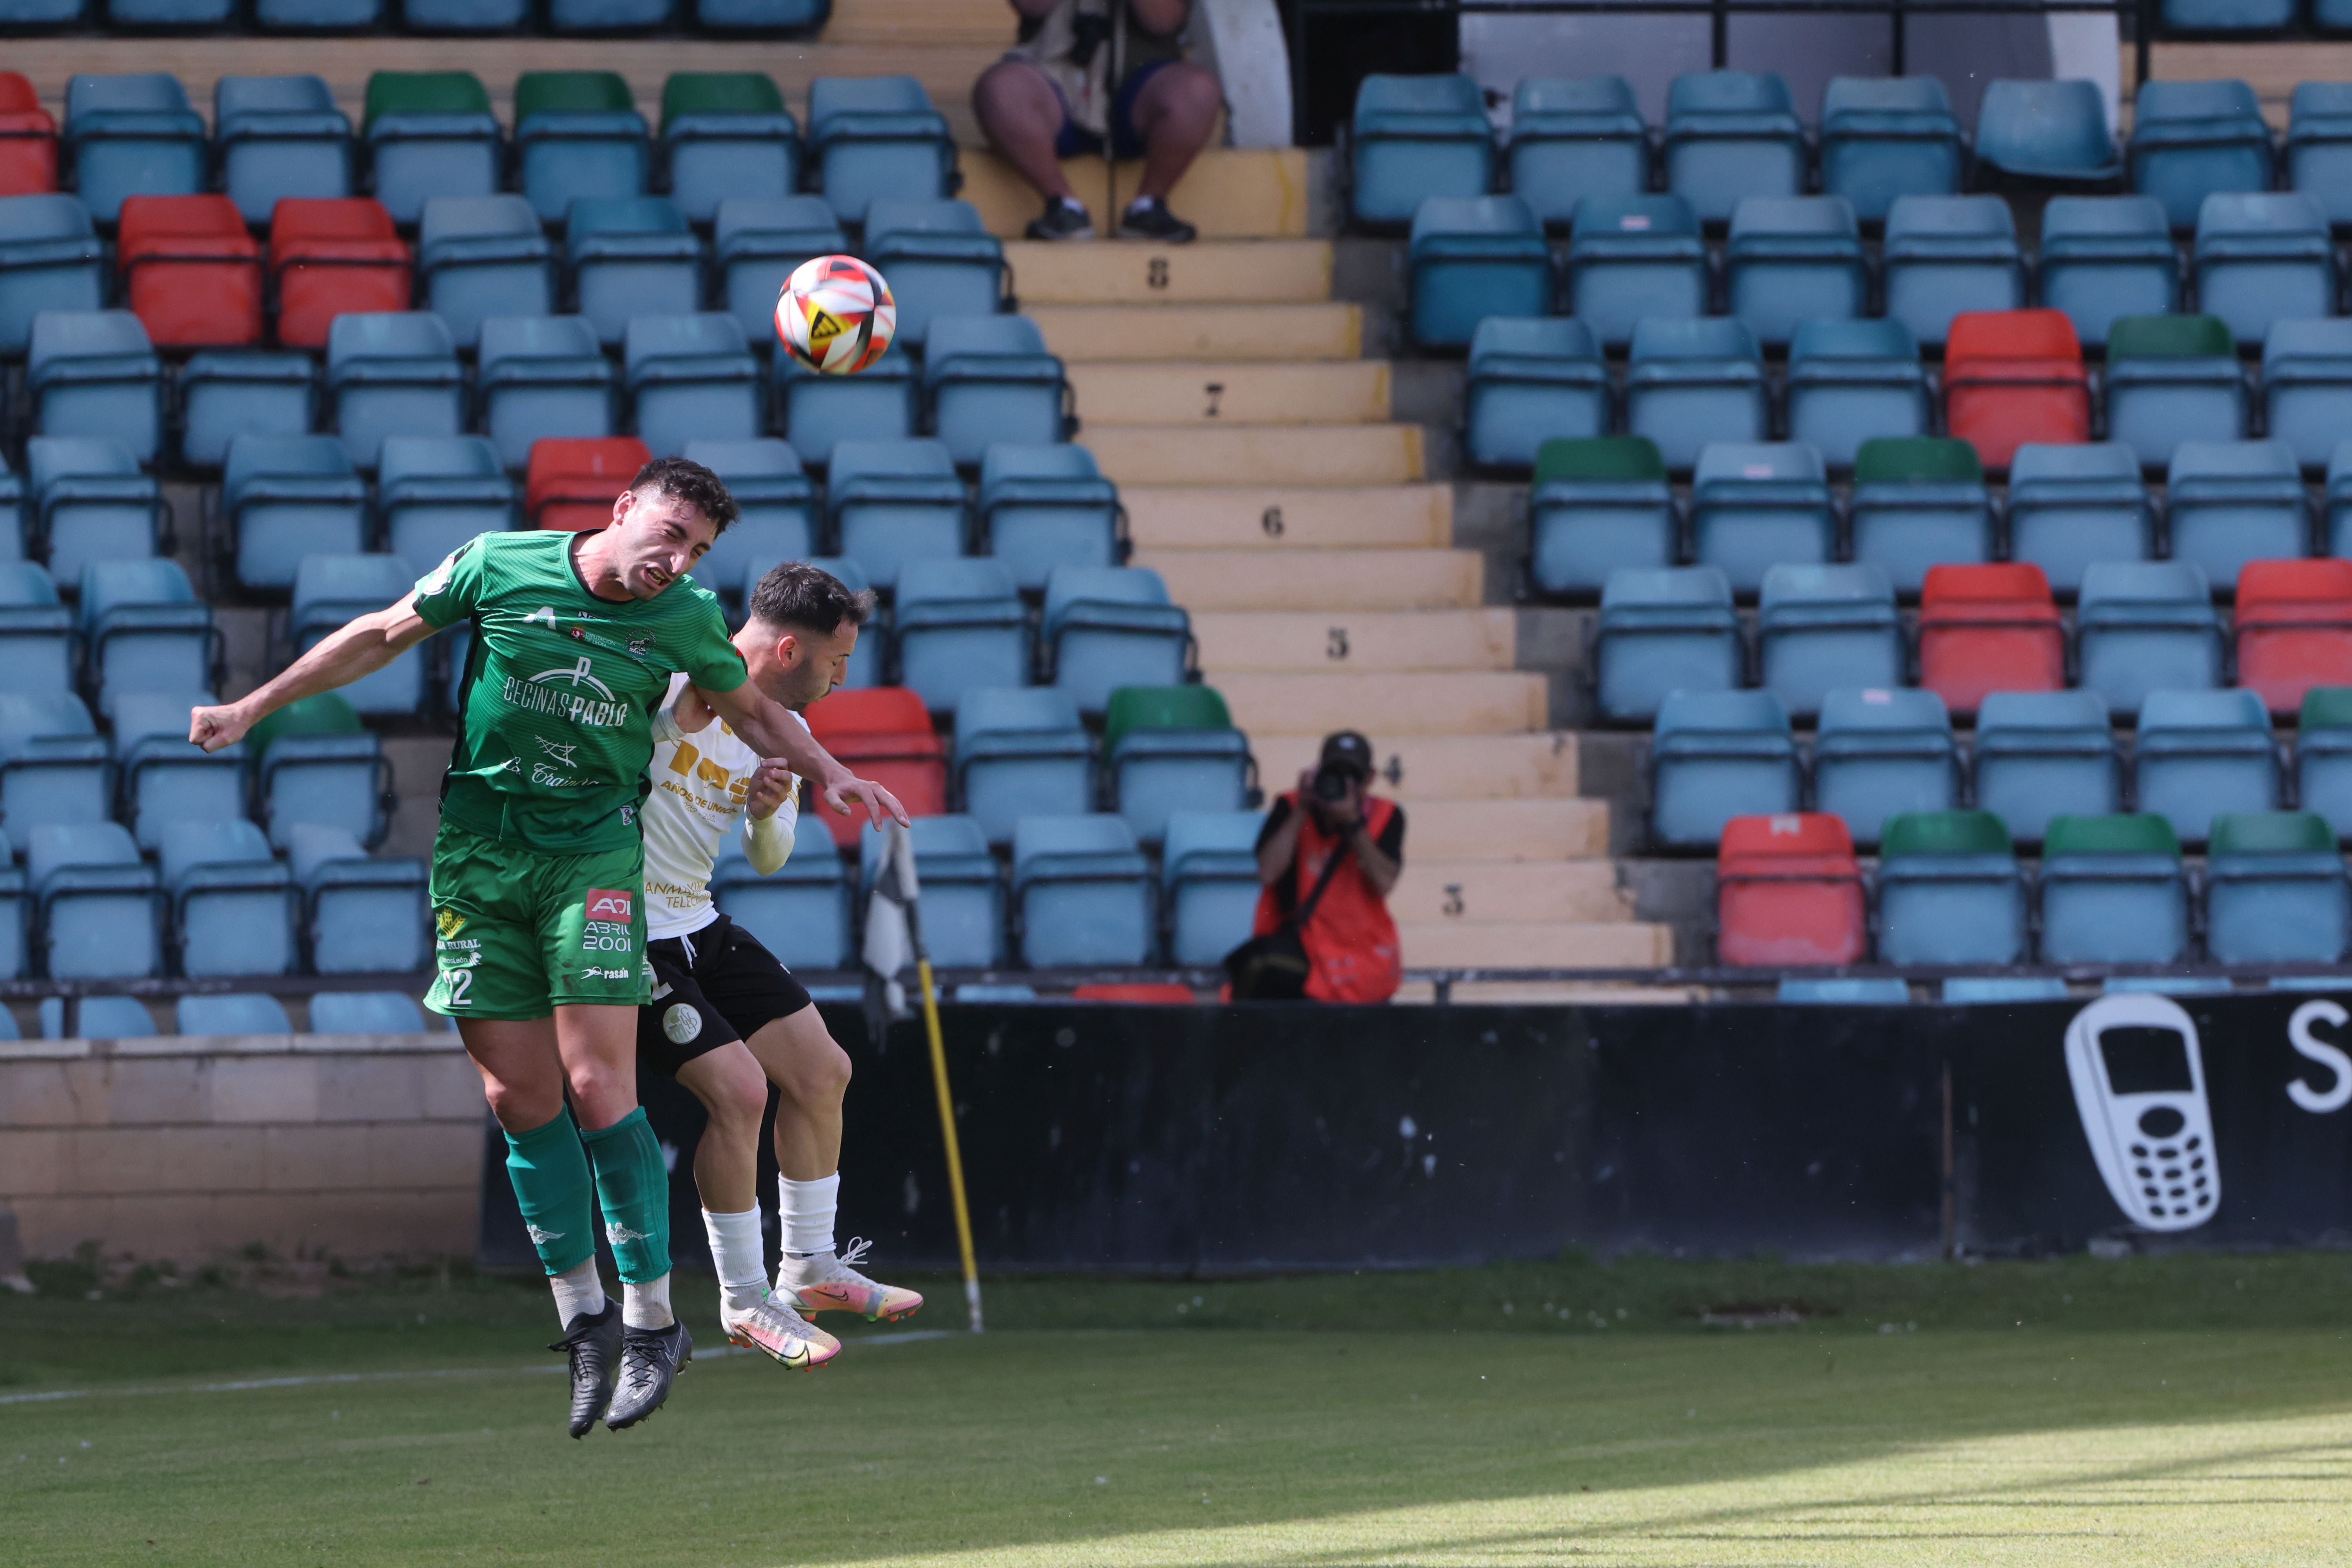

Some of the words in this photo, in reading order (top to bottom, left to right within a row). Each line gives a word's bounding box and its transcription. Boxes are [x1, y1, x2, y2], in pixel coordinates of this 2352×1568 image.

[1147, 258, 1170, 289] 8
[1204, 383, 1224, 417] 7
[1261, 506, 1285, 538] 6
[1326, 627, 1350, 661] 5
[503, 677, 569, 717] CECINAS
[569, 696, 627, 726] PABLO
[661, 780, 694, 802] AÑOS
[695, 796, 708, 808] DE
[1441, 883, 1465, 916] 3
[583, 935, 632, 952] 2001
[584, 921, 631, 935] ABRIL
[446, 939, 481, 950] RURAL
[604, 967, 629, 979] rasán
